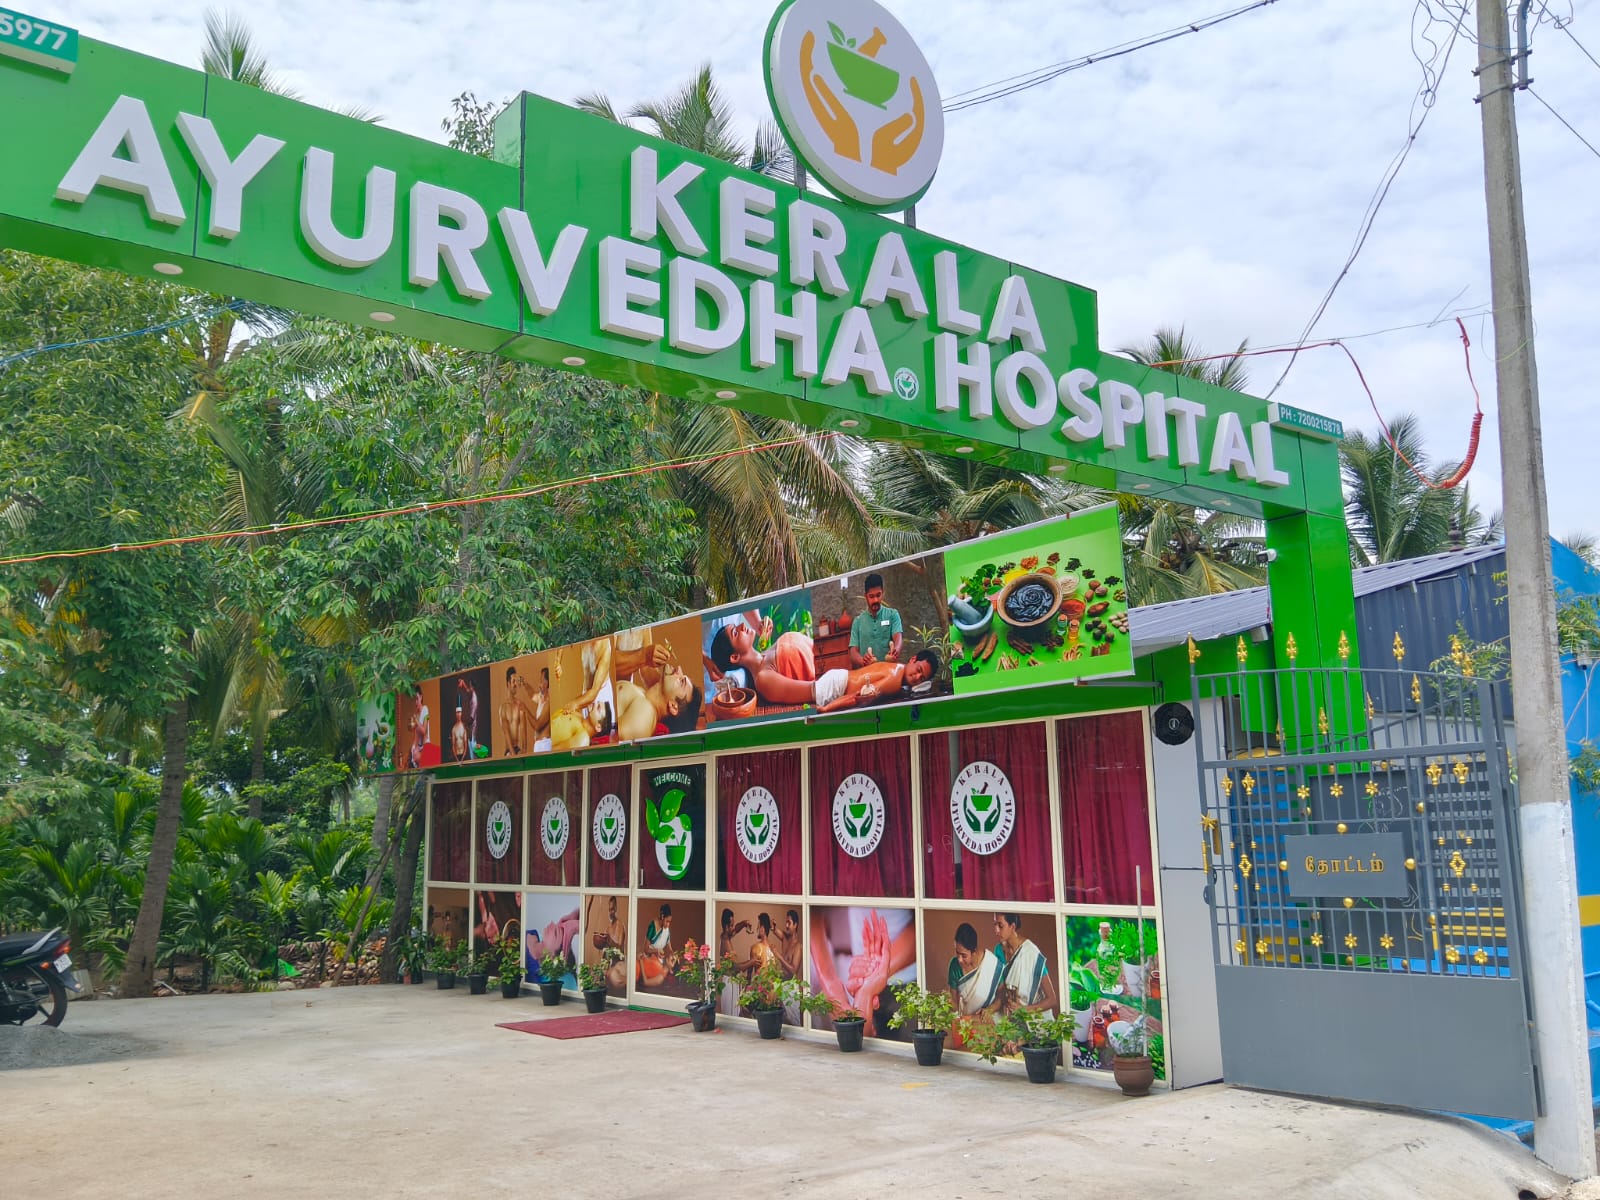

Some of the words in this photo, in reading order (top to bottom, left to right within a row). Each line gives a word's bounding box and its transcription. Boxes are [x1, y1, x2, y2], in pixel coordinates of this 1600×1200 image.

[0, 12, 68, 51] 5977
[630, 145, 1046, 354] KERALA
[55, 94, 893, 396] AYURVEDHA
[933, 331, 1290, 488] HOSPITAL
[653, 772, 692, 787] WELCOME
[838, 776, 877, 797] KERALA
[958, 764, 1005, 787] KERALA
[741, 788, 773, 808] KERALA
[833, 809, 860, 856] AYURVEDA
[860, 806, 883, 855] HOSPITAL
[952, 799, 983, 853] AYURVEDA
[984, 799, 1013, 853] HOSPITAL
[1305, 852, 1384, 876] தோட்டம்
